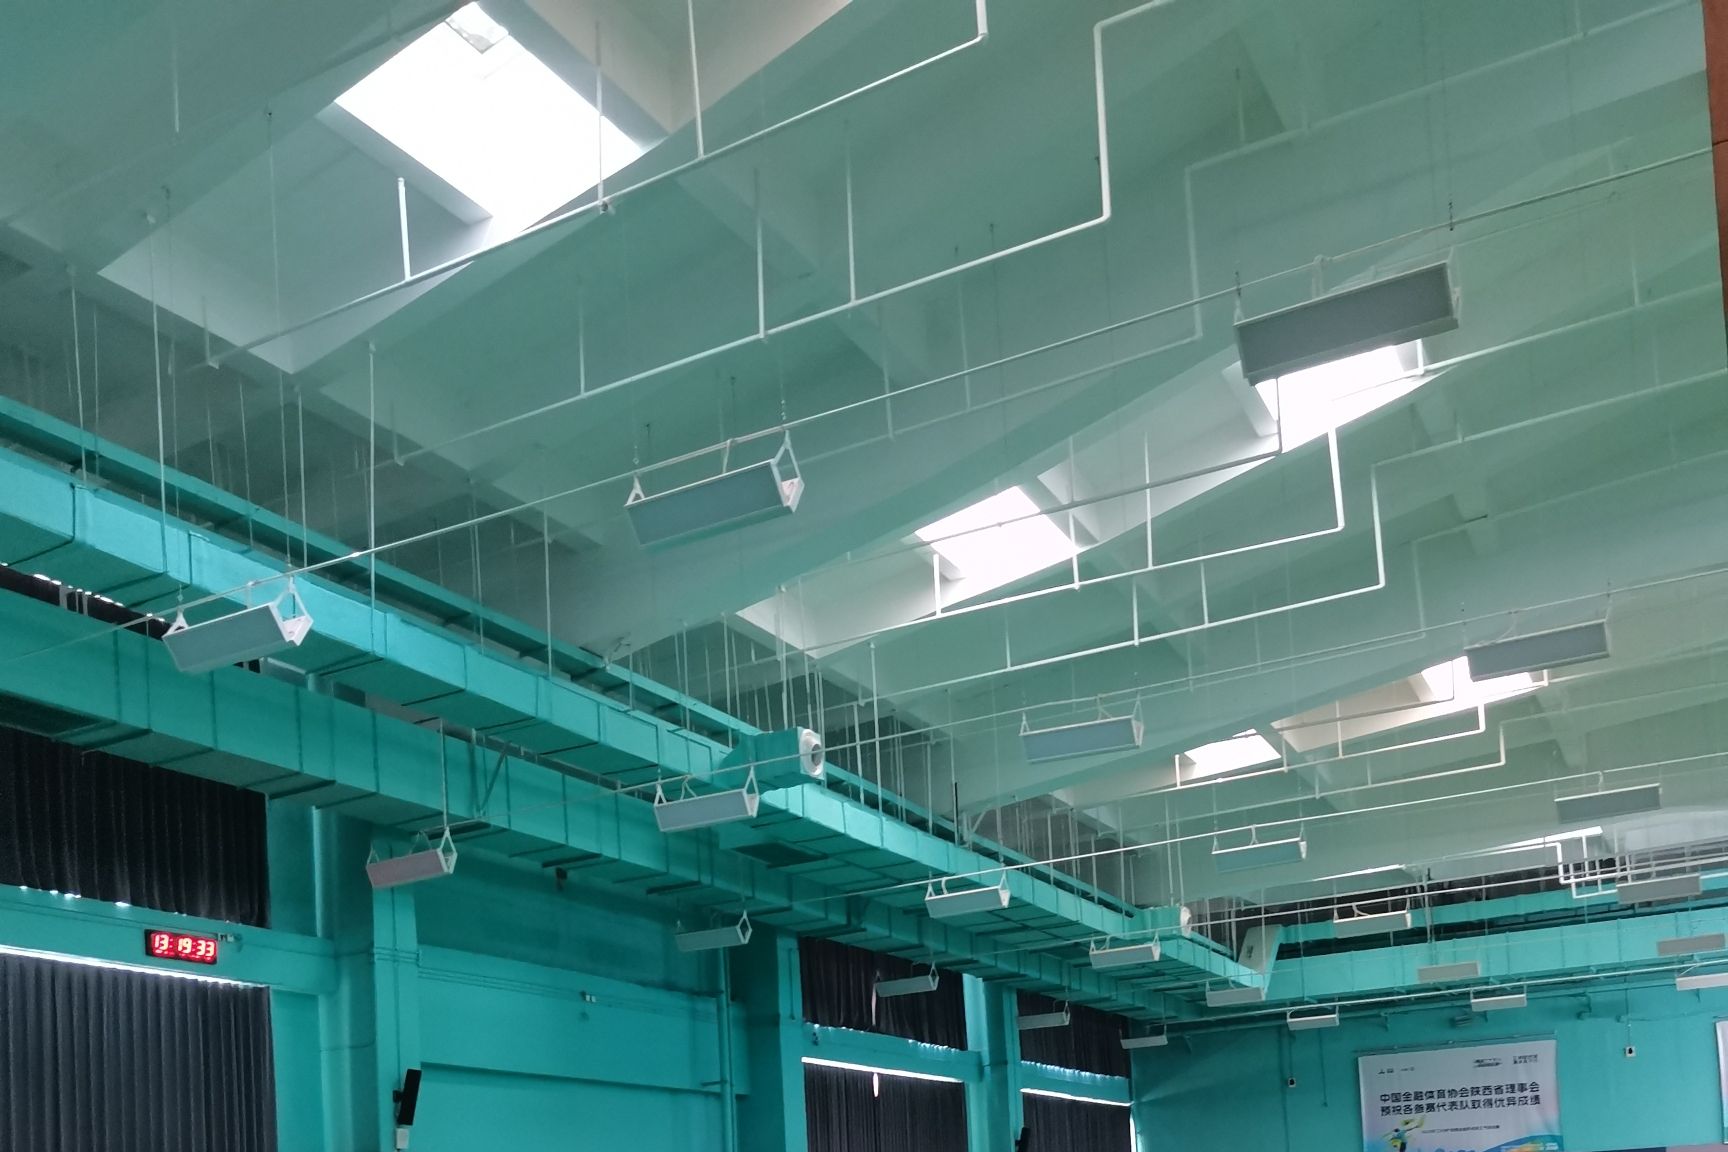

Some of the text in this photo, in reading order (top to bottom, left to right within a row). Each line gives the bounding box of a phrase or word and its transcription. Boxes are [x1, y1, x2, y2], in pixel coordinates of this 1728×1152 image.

[1380, 1081, 1541, 1103] 中国金融体育协会陕西省理事会
[1380, 1094, 1541, 1117] 预祝各参赛代表队取得优异成绩
